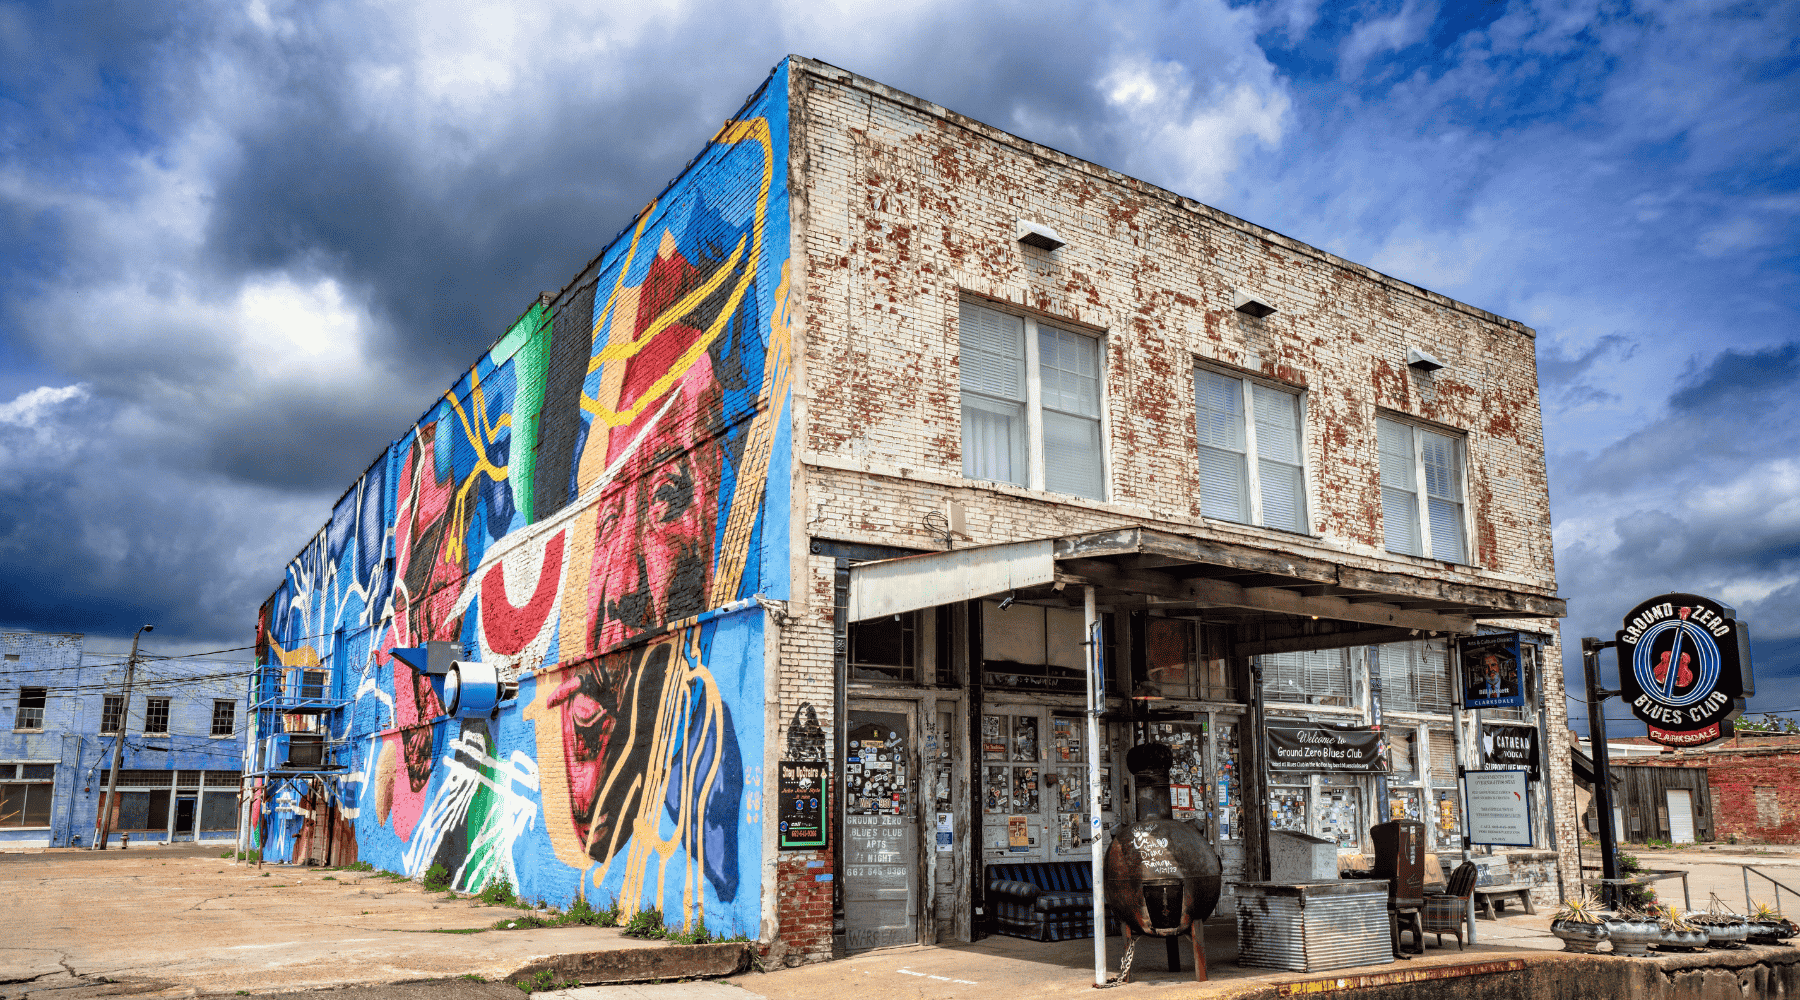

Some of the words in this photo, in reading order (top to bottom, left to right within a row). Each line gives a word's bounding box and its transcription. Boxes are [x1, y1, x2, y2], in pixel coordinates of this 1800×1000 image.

[1622, 603, 1673, 644] GROUND
[1691, 605, 1730, 637] ZERO
[1634, 694, 1682, 724] BLUES
[1689, 691, 1728, 722] CLUB
[1297, 731, 1336, 744] Welcome
[1338, 736, 1346, 744] to
[1651, 728, 1717, 743] CLARKSDALE
[1497, 736, 1530, 749] CATHEAD
[1278, 747, 1302, 757] Ground
[1305, 748, 1322, 757] Zero
[1324, 748, 1344, 758] Blues
[1347, 749, 1362, 758] Club
[782, 766, 795, 780] Stay
[796, 766, 818, 780] UpStairs
[847, 817, 877, 825] GROUND
[882, 817, 902, 825] ZERO
[852, 828, 877, 837] BLUES
[867, 840, 886, 848] APTS
[868, 854, 892, 862] NIGHT
[847, 868, 863, 876] 662
